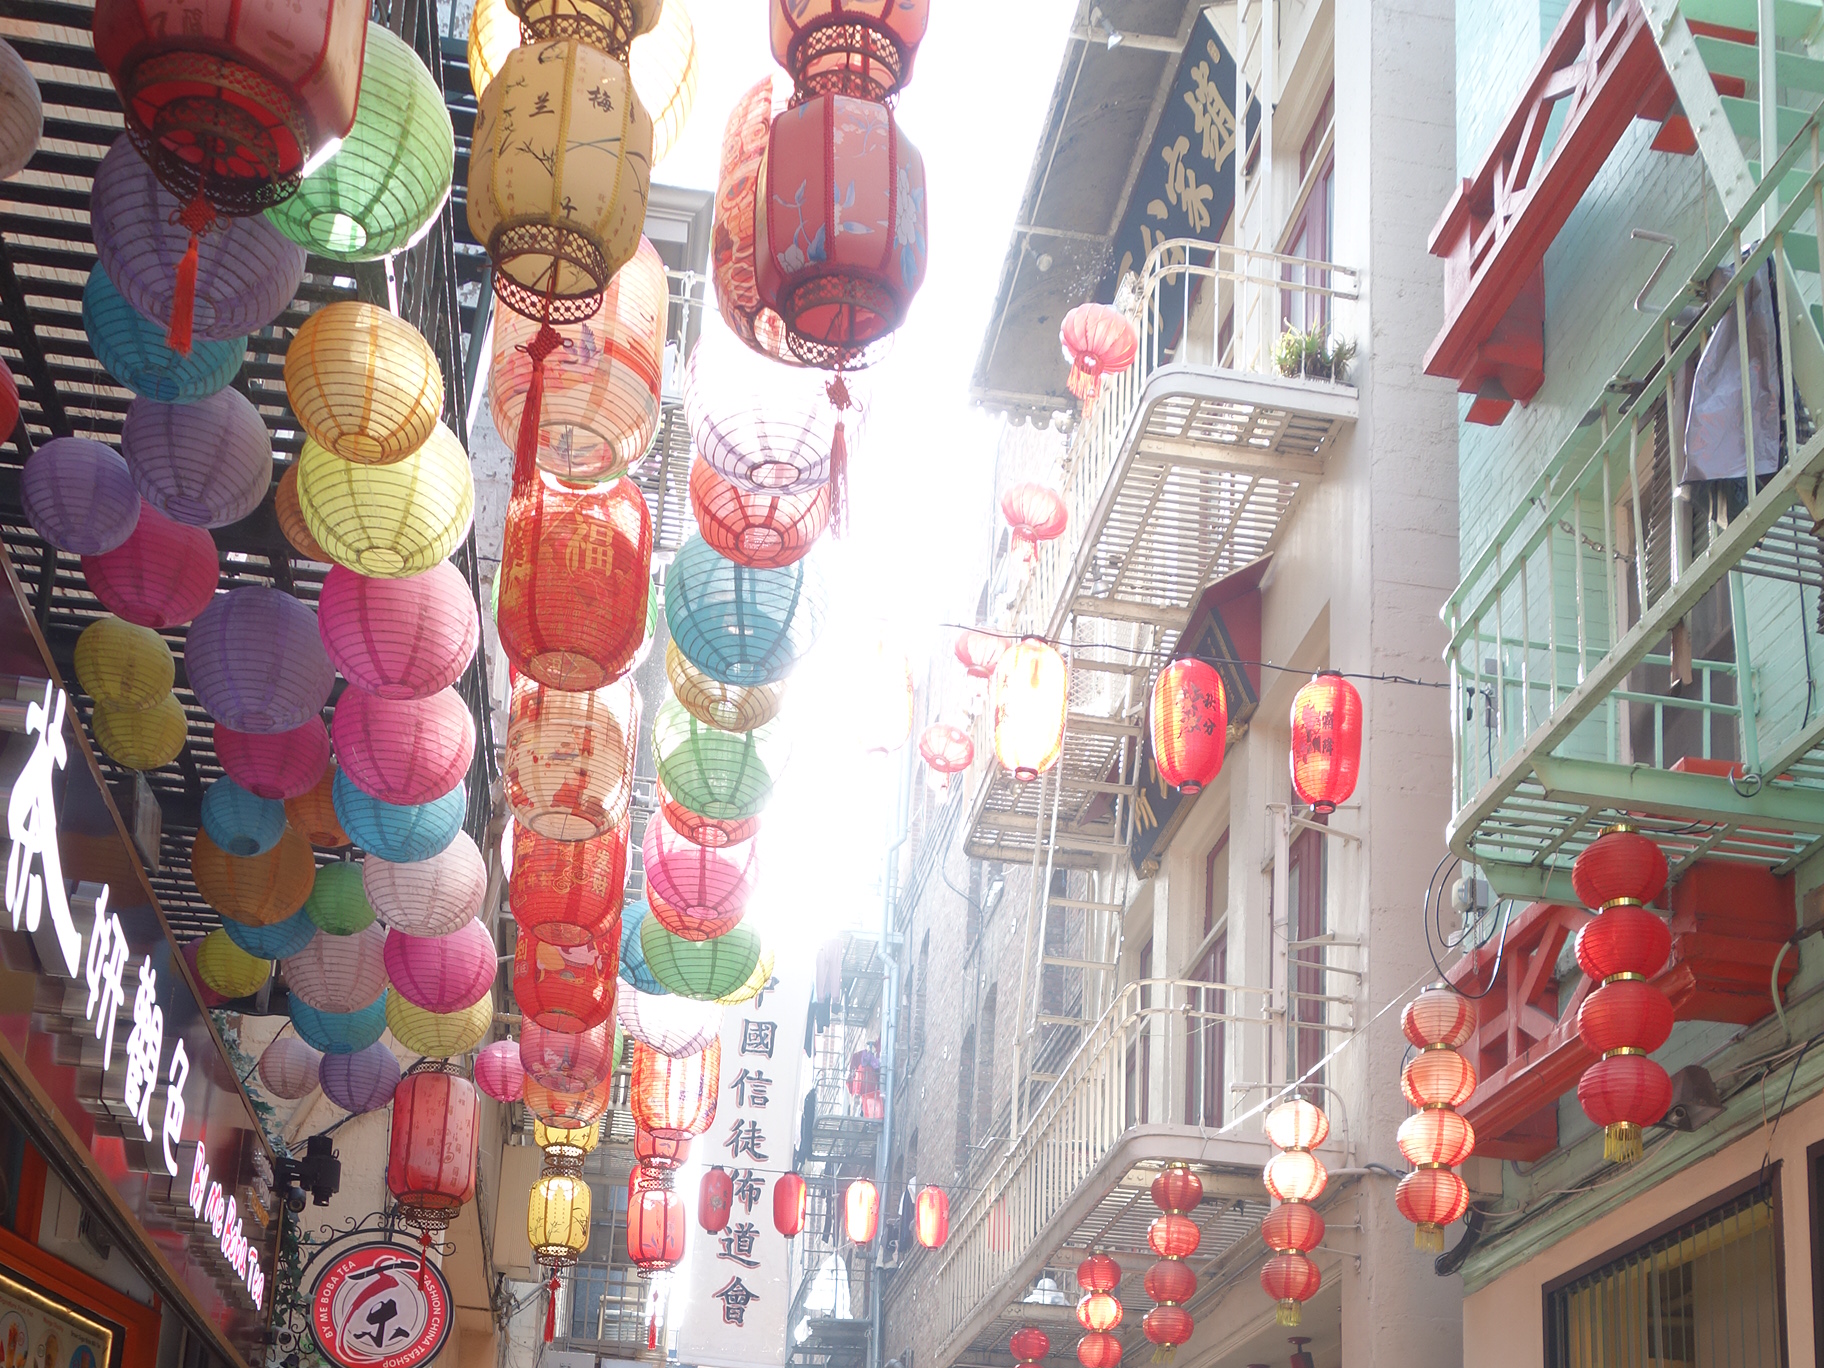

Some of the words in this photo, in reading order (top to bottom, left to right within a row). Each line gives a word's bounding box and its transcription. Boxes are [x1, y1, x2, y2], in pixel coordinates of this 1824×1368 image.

[565, 512, 615, 578] 福
[190, 1141, 209, 1218] By
[205, 1181, 224, 1238] Me
[221, 1195, 248, 1280] Boba
[247, 1247, 264, 1311] Tea
[336, 1260, 356, 1276] TEA
[321, 1276, 340, 1304] BOBA
[422, 1274, 441, 1315] FASHION
[319, 1306, 329, 1322] ME
[321, 1326, 334, 1339] BY
[422, 1316, 441, 1346] CHINA
[382, 1345, 426, 1368] TEASHOP
